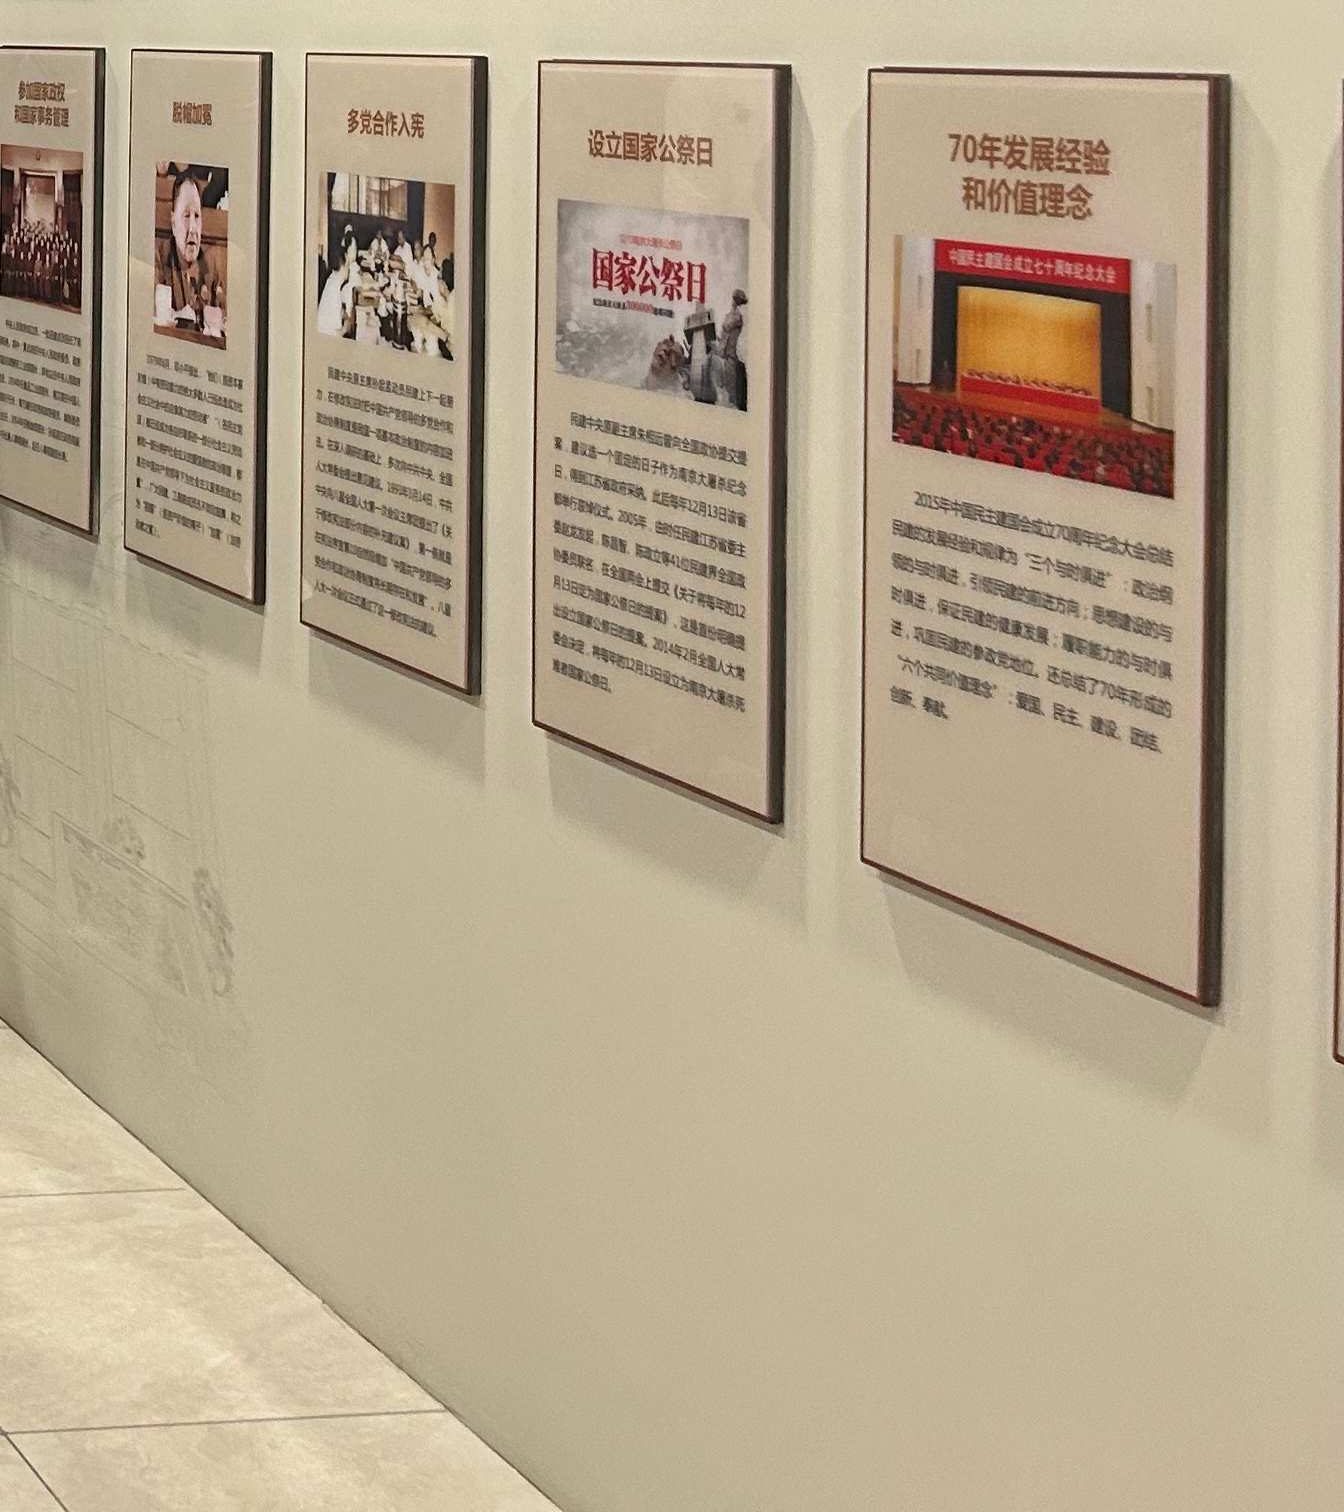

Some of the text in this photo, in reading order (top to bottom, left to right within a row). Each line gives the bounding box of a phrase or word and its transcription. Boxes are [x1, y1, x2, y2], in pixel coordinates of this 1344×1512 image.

[173, 101, 213, 126] 脱帽加冕
[347, 108, 425, 139] 多党合作入宪
[587, 129, 713, 167] 设立国家公祭日
[948, 133, 1111, 176] 70年发展经验
[962, 177, 1093, 221] 和价值理念
[592, 248, 708, 303] 国家公祭日
